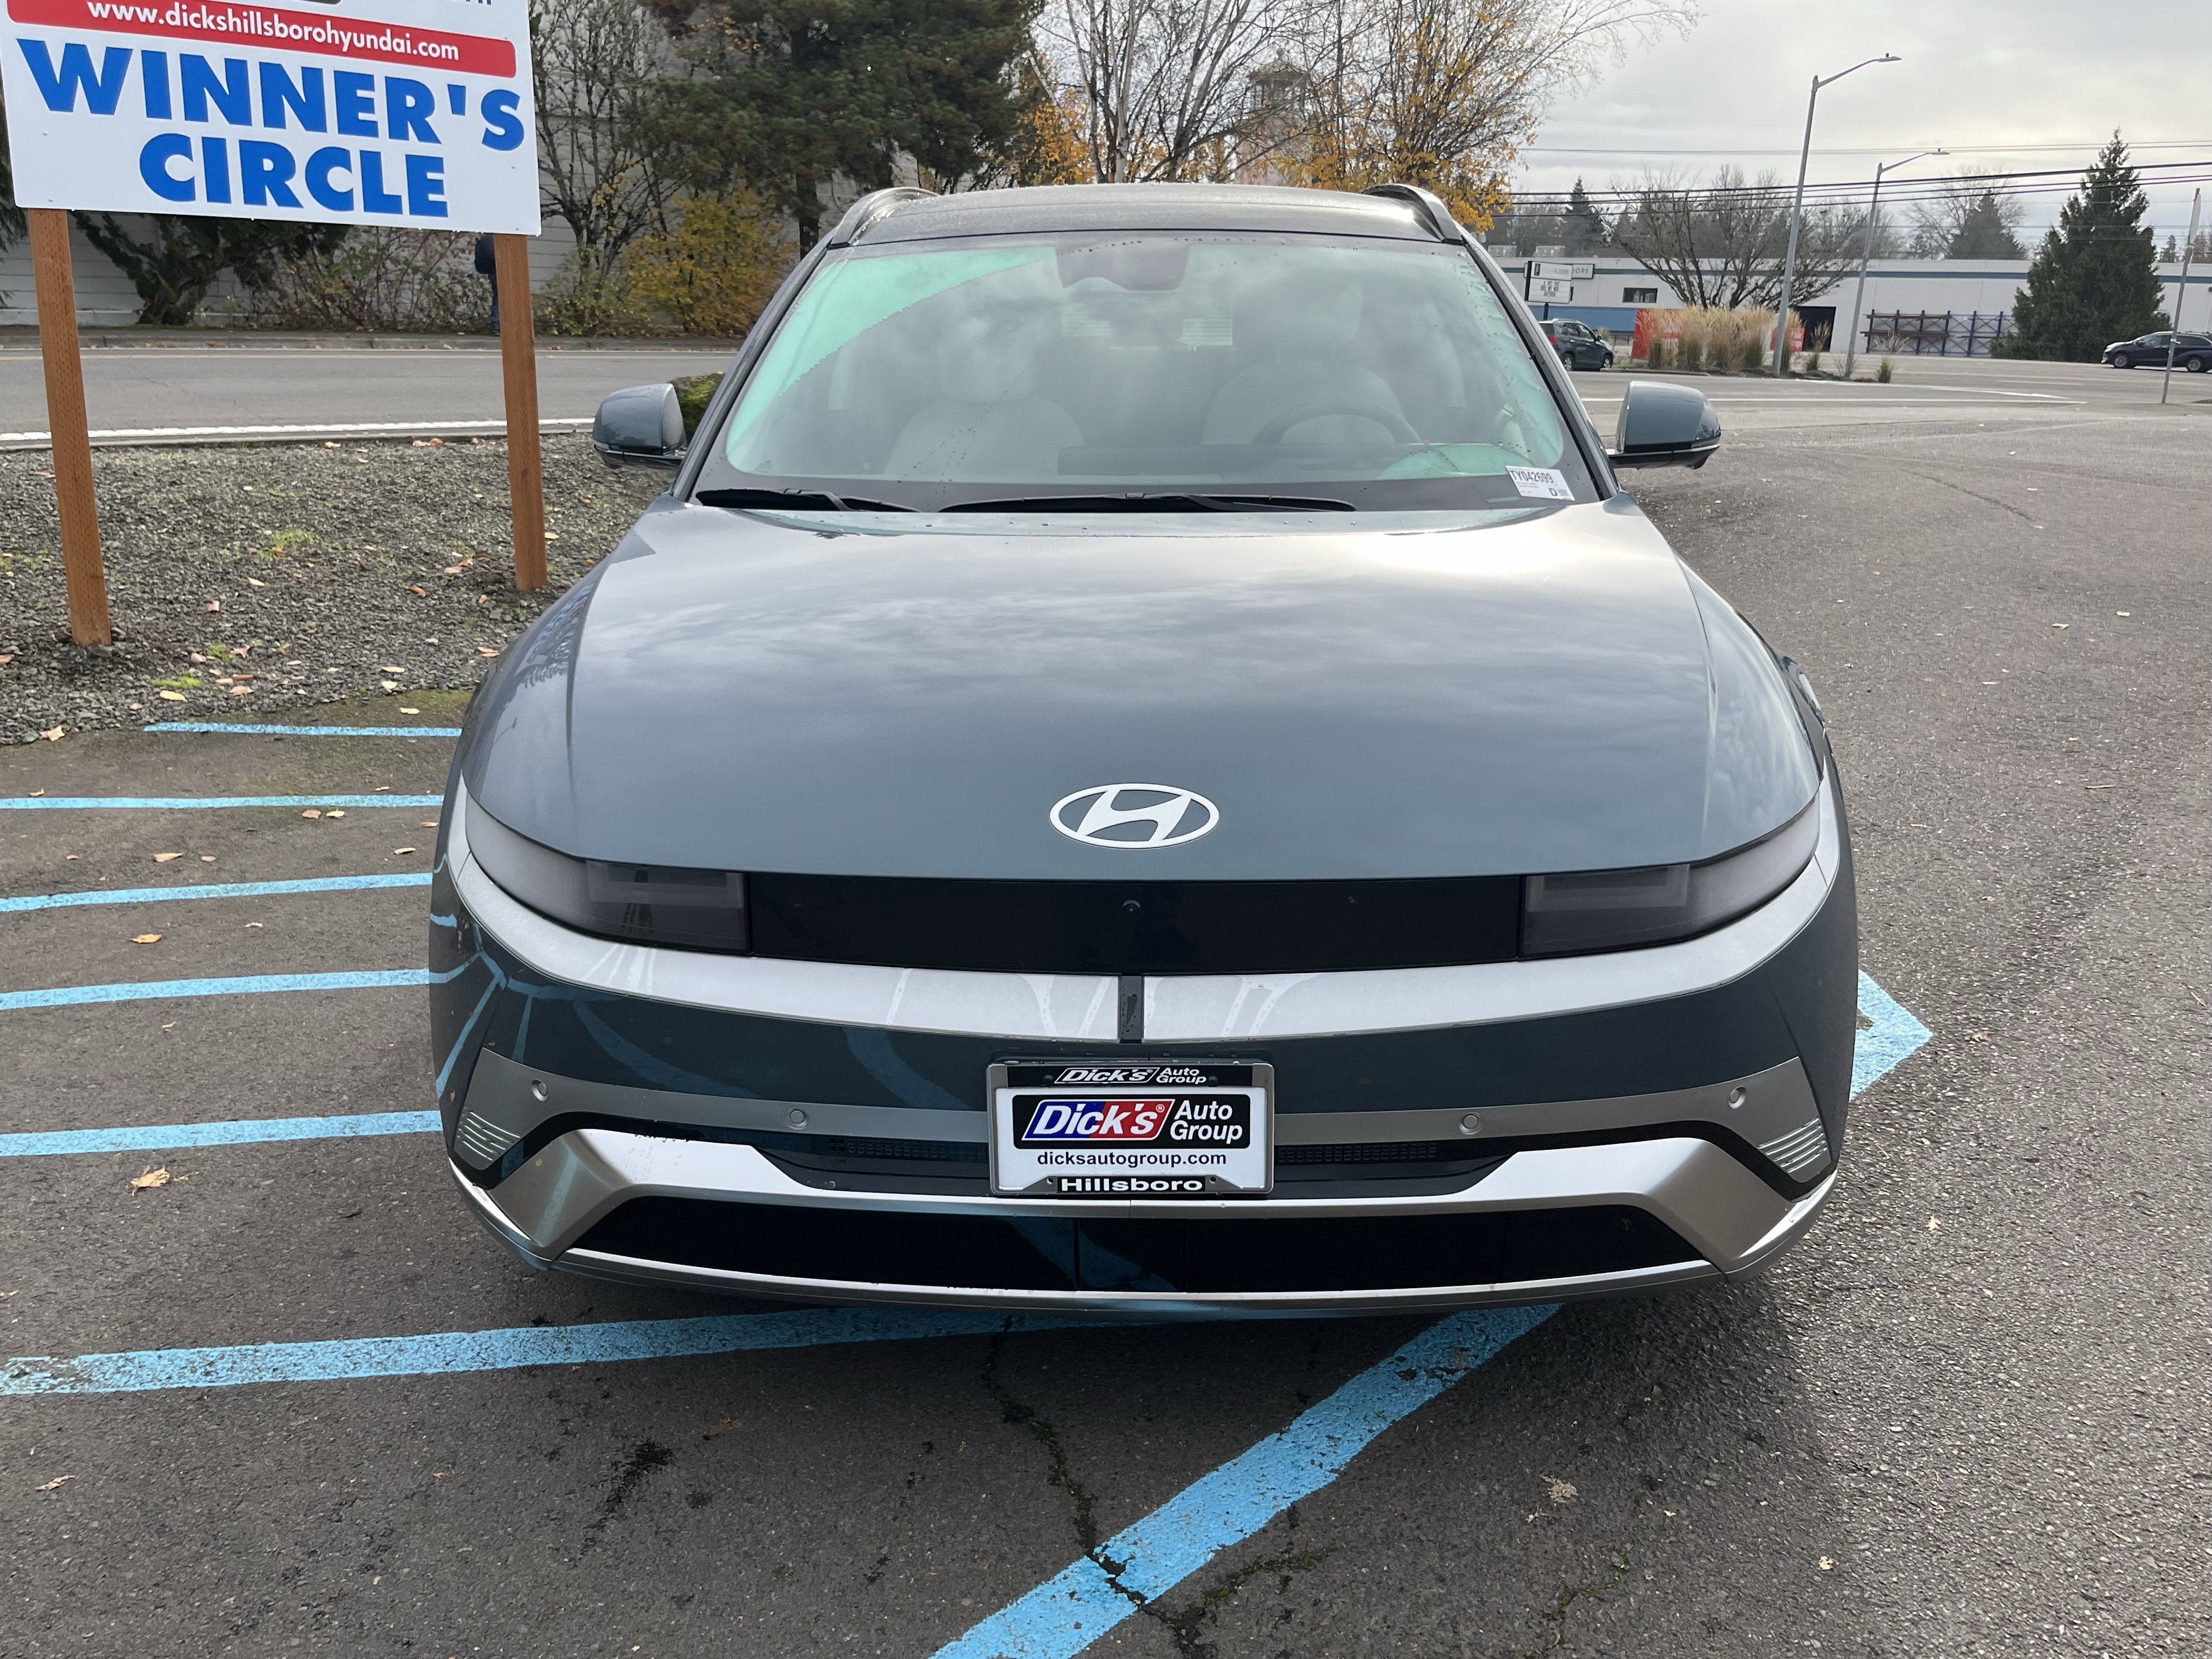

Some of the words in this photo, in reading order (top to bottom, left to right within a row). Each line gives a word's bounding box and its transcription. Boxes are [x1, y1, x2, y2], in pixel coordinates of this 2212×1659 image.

[87, 2, 459, 60] www.dickshillsborohyundai.com
[16, 38, 524, 151] WINNER'S
[139, 133, 448, 218] CIRCLE
[1509, 470, 1554, 483] TY042699
[1156, 1075, 1207, 1085] Group
[1160, 1068, 1200, 1076] Auto
[1033, 1103, 1158, 1135] Dick's
[1174, 1100, 1233, 1120] Auto
[1170, 1120, 1243, 1144] Group
[1037, 1152, 1226, 1167] dicksautogroup.com
[1061, 1178, 1203, 1192] Hillsboro
